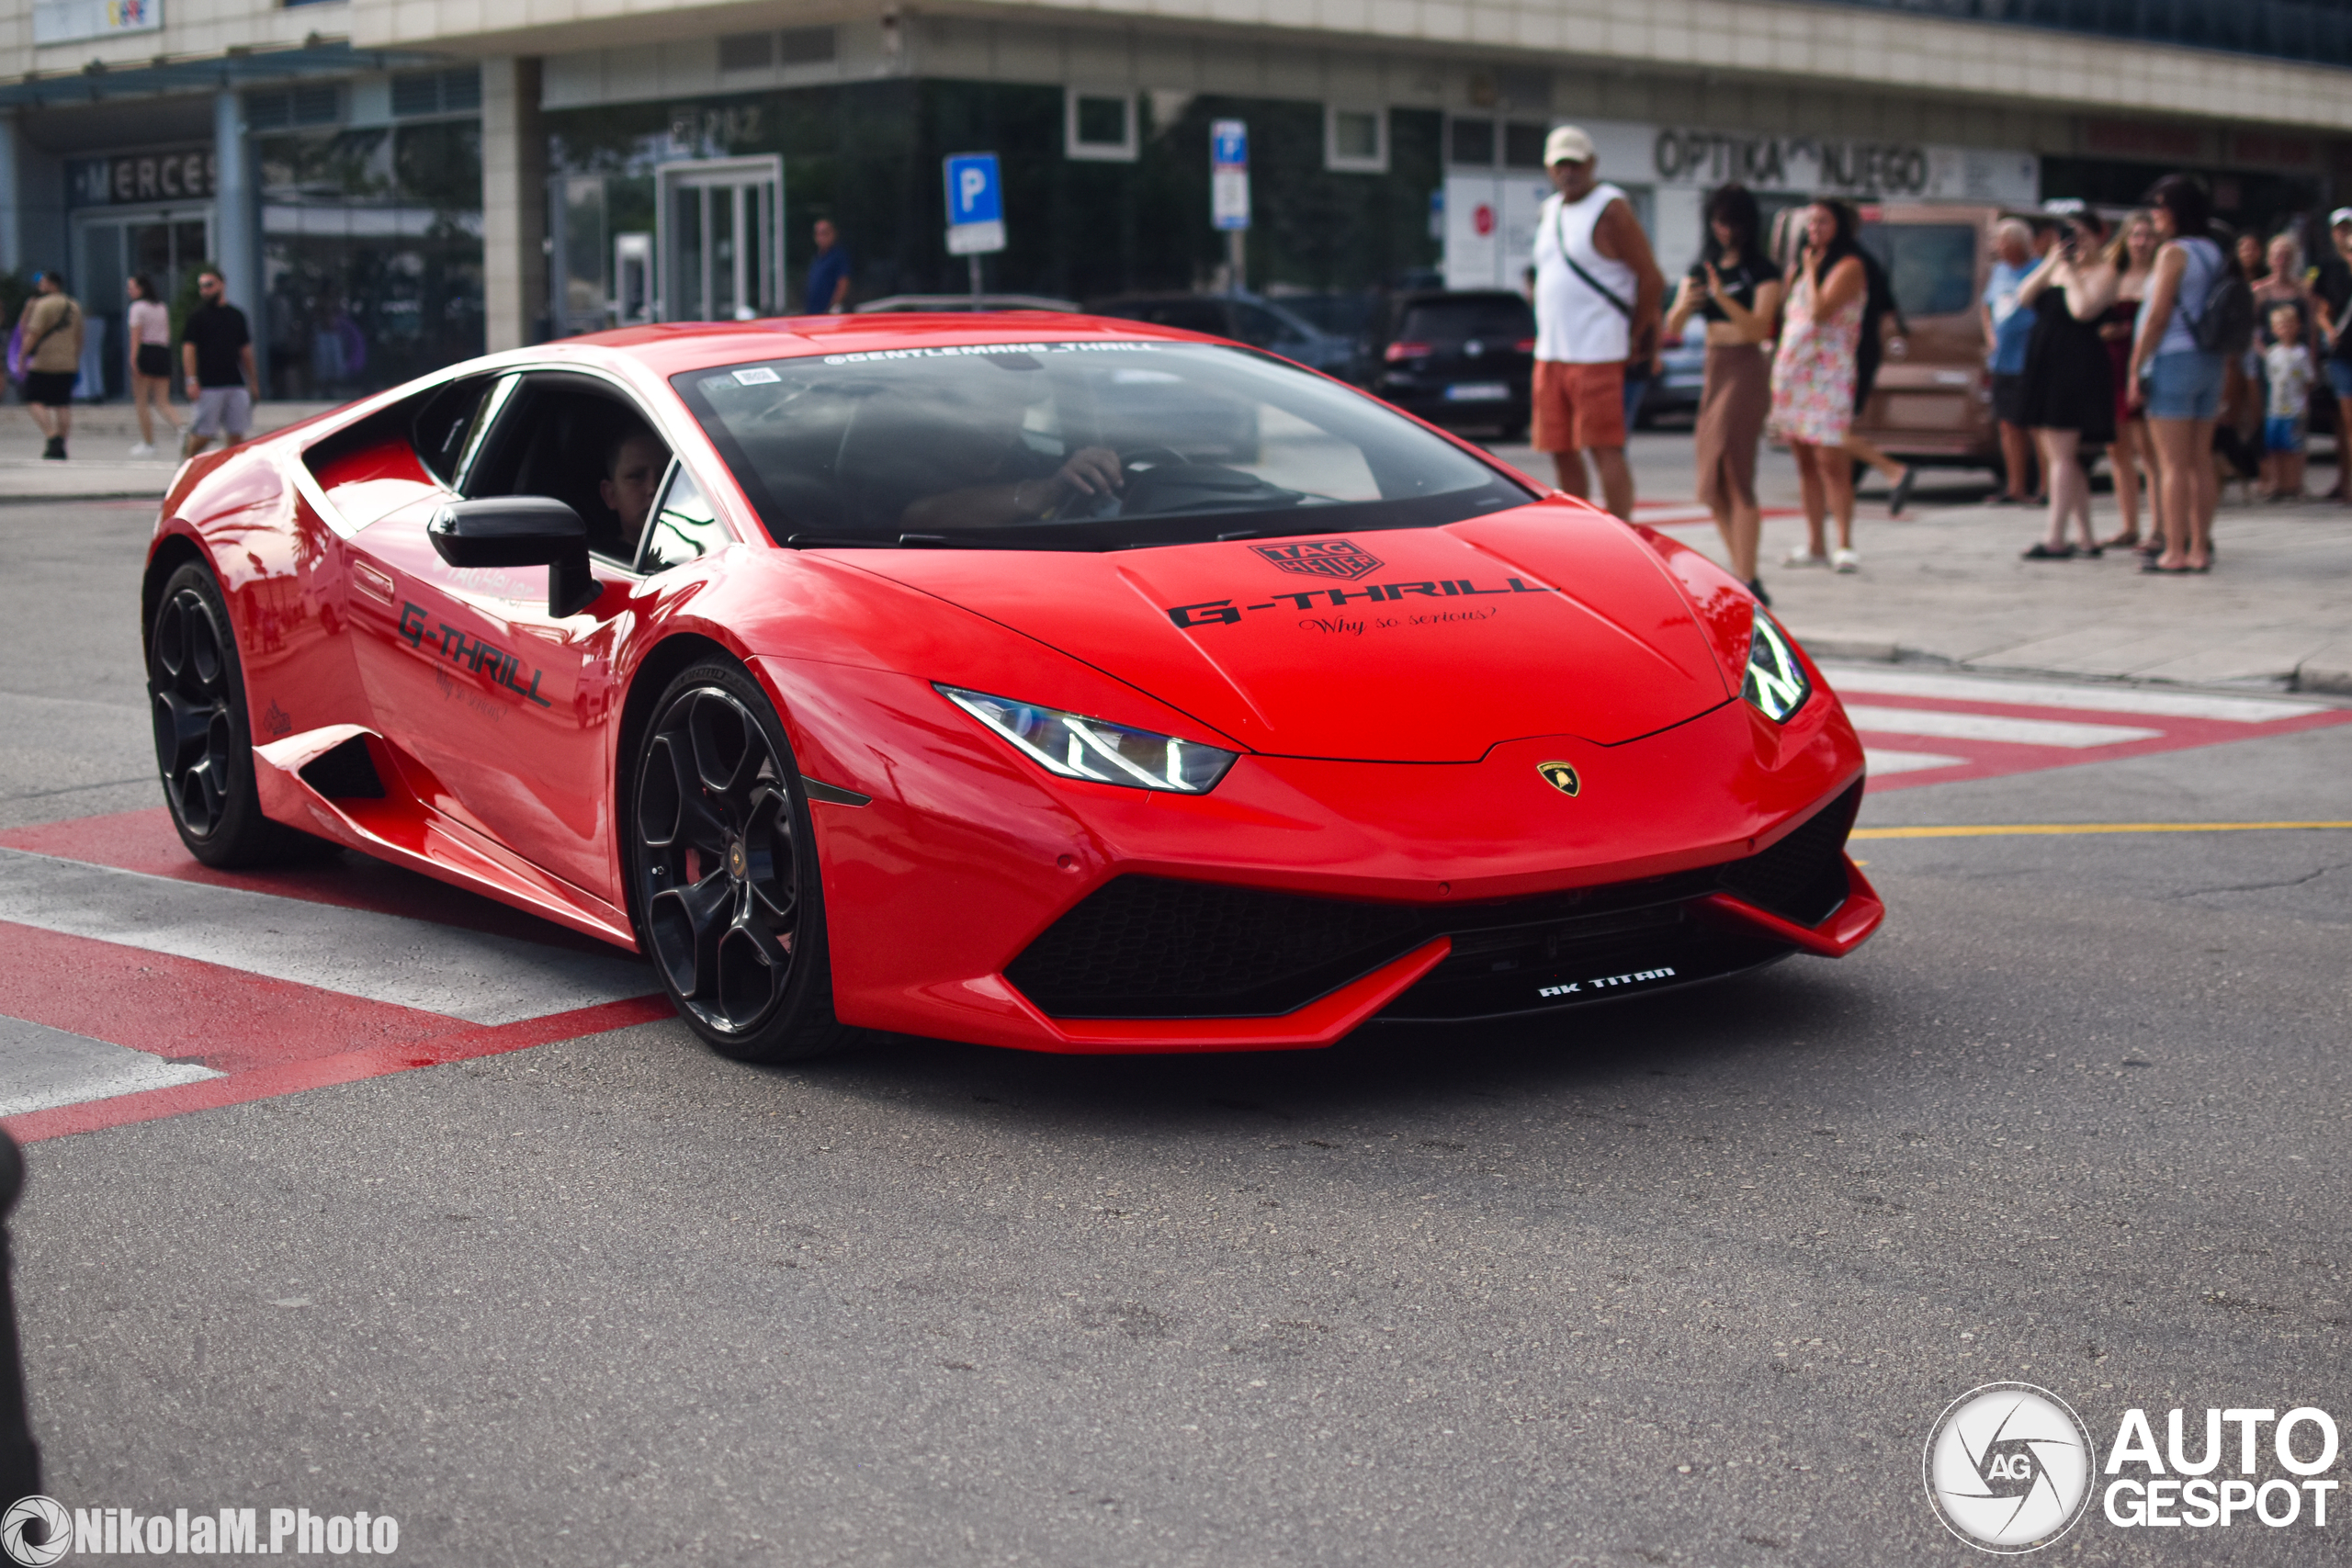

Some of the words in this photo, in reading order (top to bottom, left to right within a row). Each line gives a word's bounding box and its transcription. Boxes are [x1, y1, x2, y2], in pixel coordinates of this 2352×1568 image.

[1656, 130, 1785, 182] OPTIKA
[960, 167, 986, 213] P
[1263, 542, 1355, 558] TAG
[1281, 555, 1374, 577] HEUER
[1164, 578, 1561, 629] G-THRILL
[1299, 615, 1367, 636] Why
[1375, 617, 1400, 629] so
[1409, 606, 1497, 626] serious?
[399, 601, 551, 708] G-THRILL
[1537, 983, 1581, 998] AK
[1588, 967, 1676, 988] TITAN
